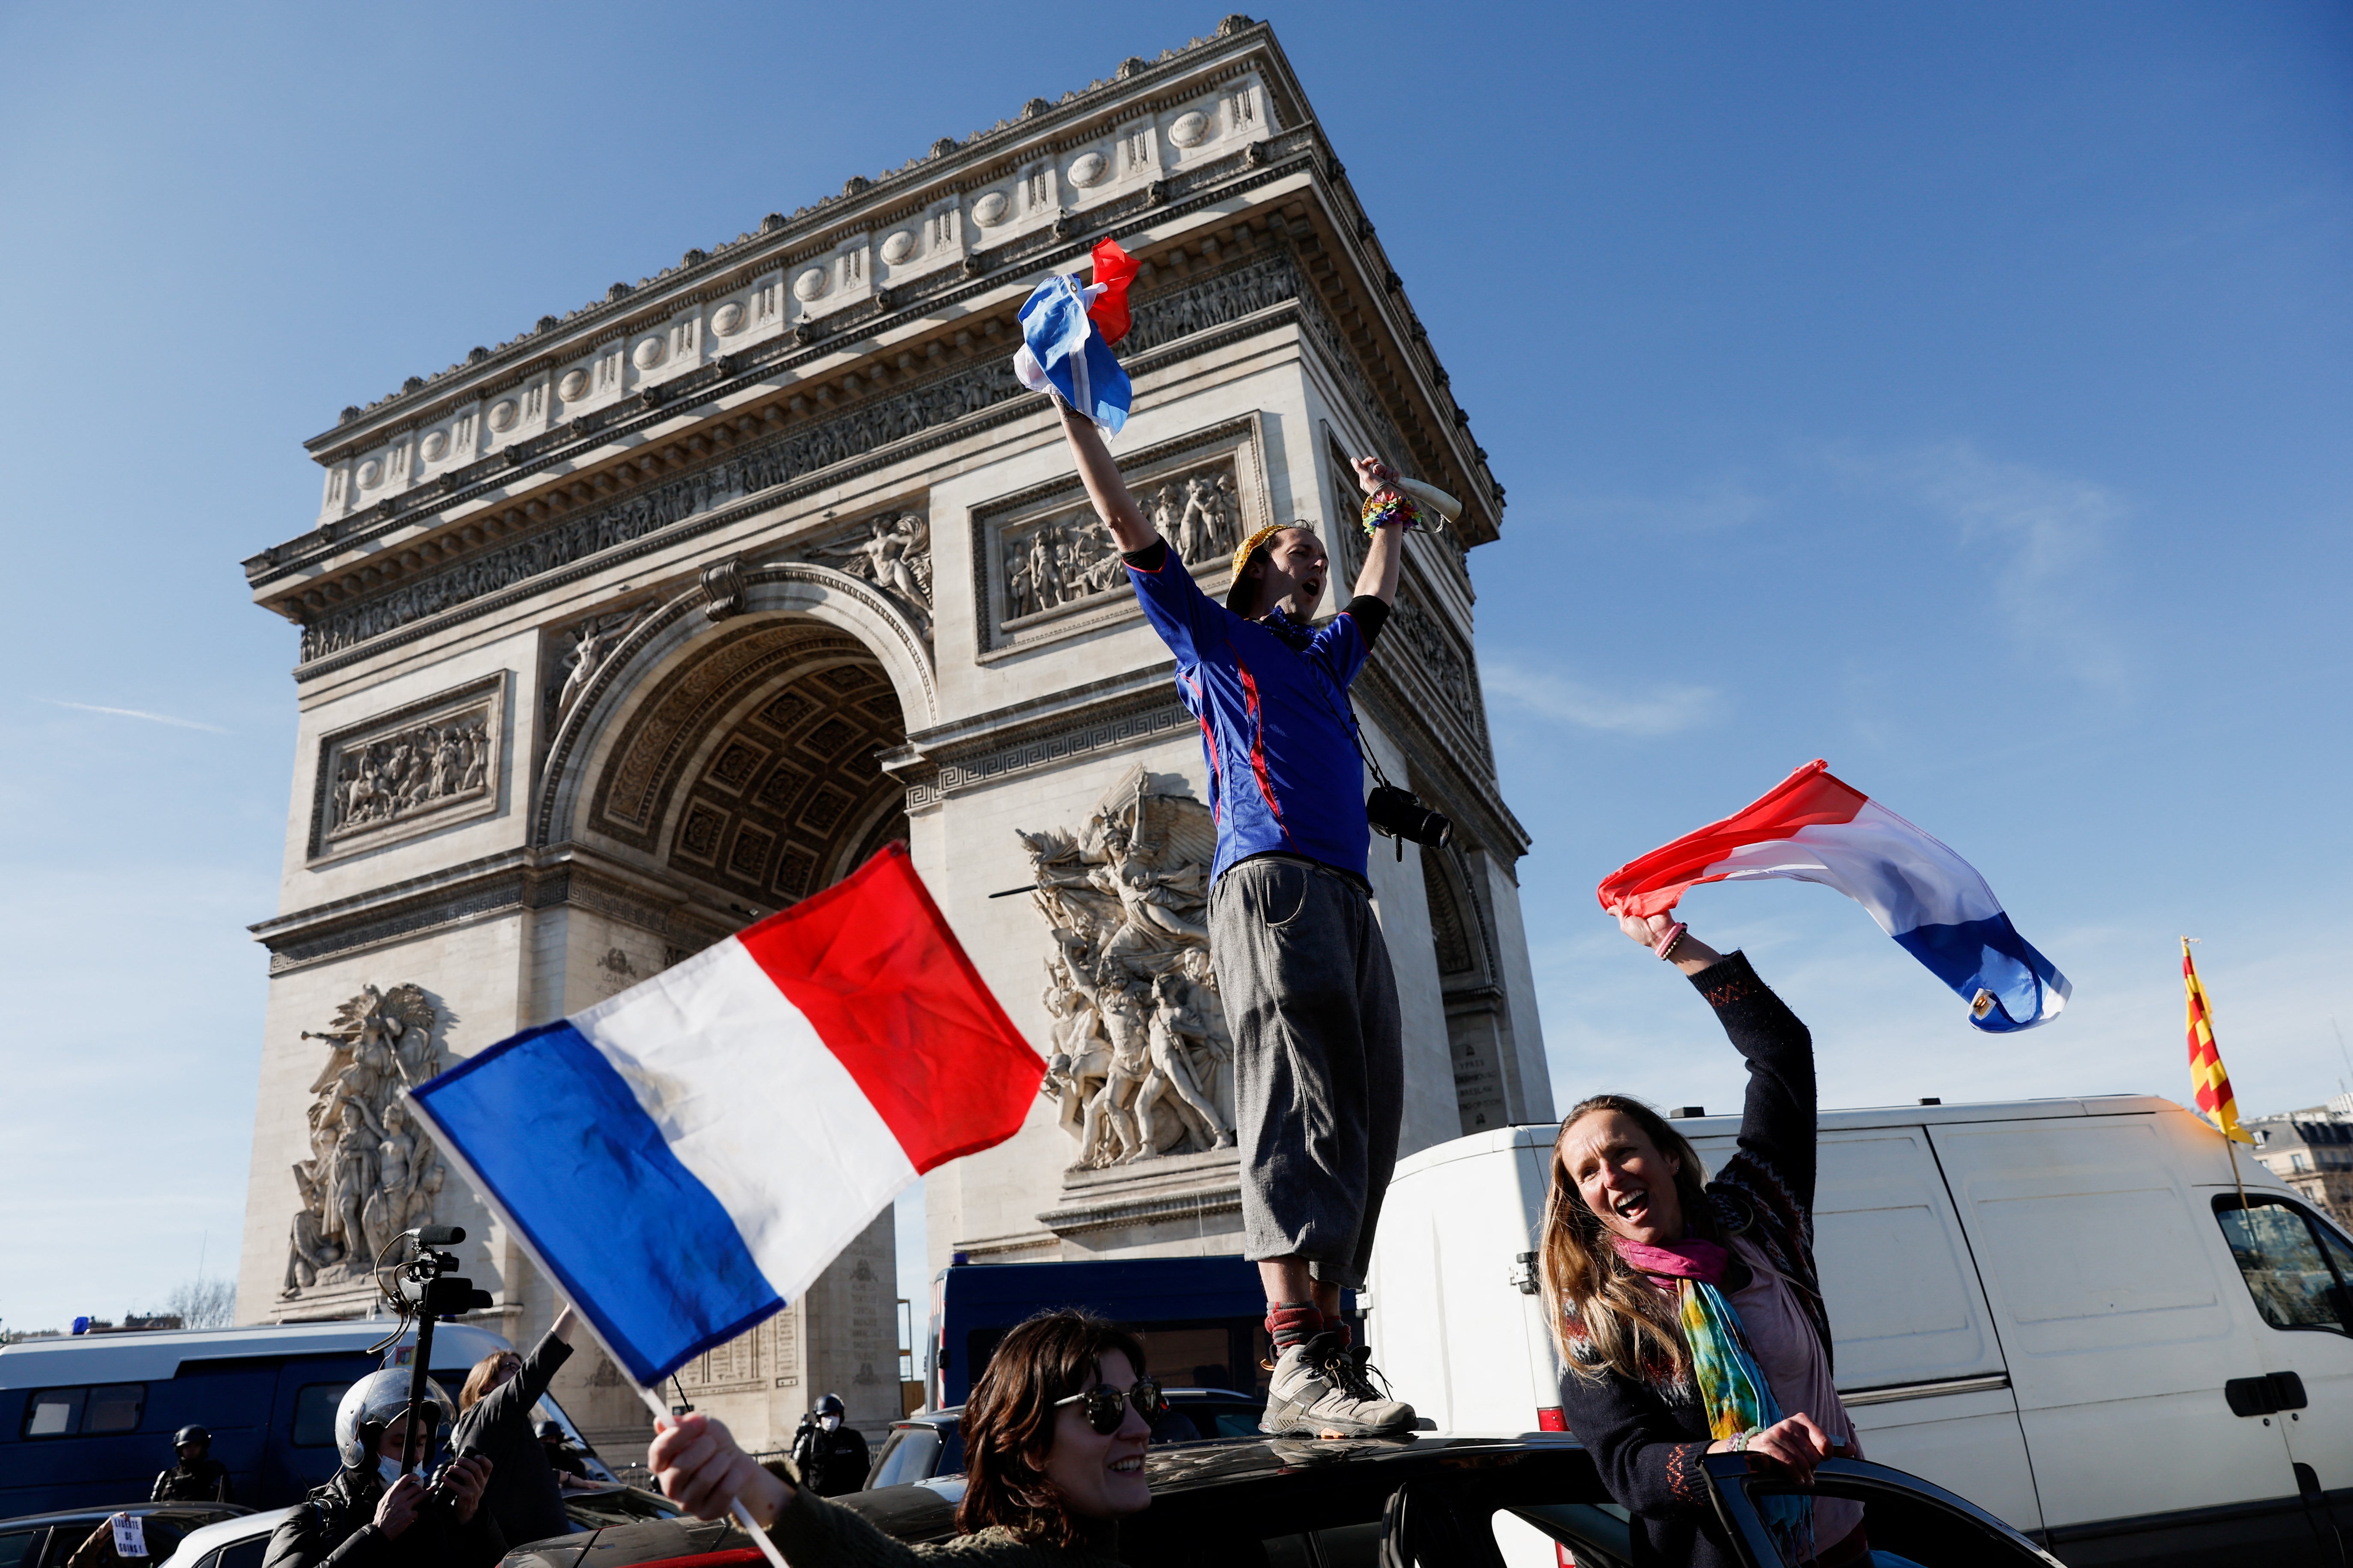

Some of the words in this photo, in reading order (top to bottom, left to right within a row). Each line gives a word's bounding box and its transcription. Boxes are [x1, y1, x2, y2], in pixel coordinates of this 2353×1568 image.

[602, 972, 631, 988] LOANO
[1459, 1059, 1485, 1069] YPRES
[125, 1532, 132, 1541] DE
[119, 1543, 138, 1553] SOINS
